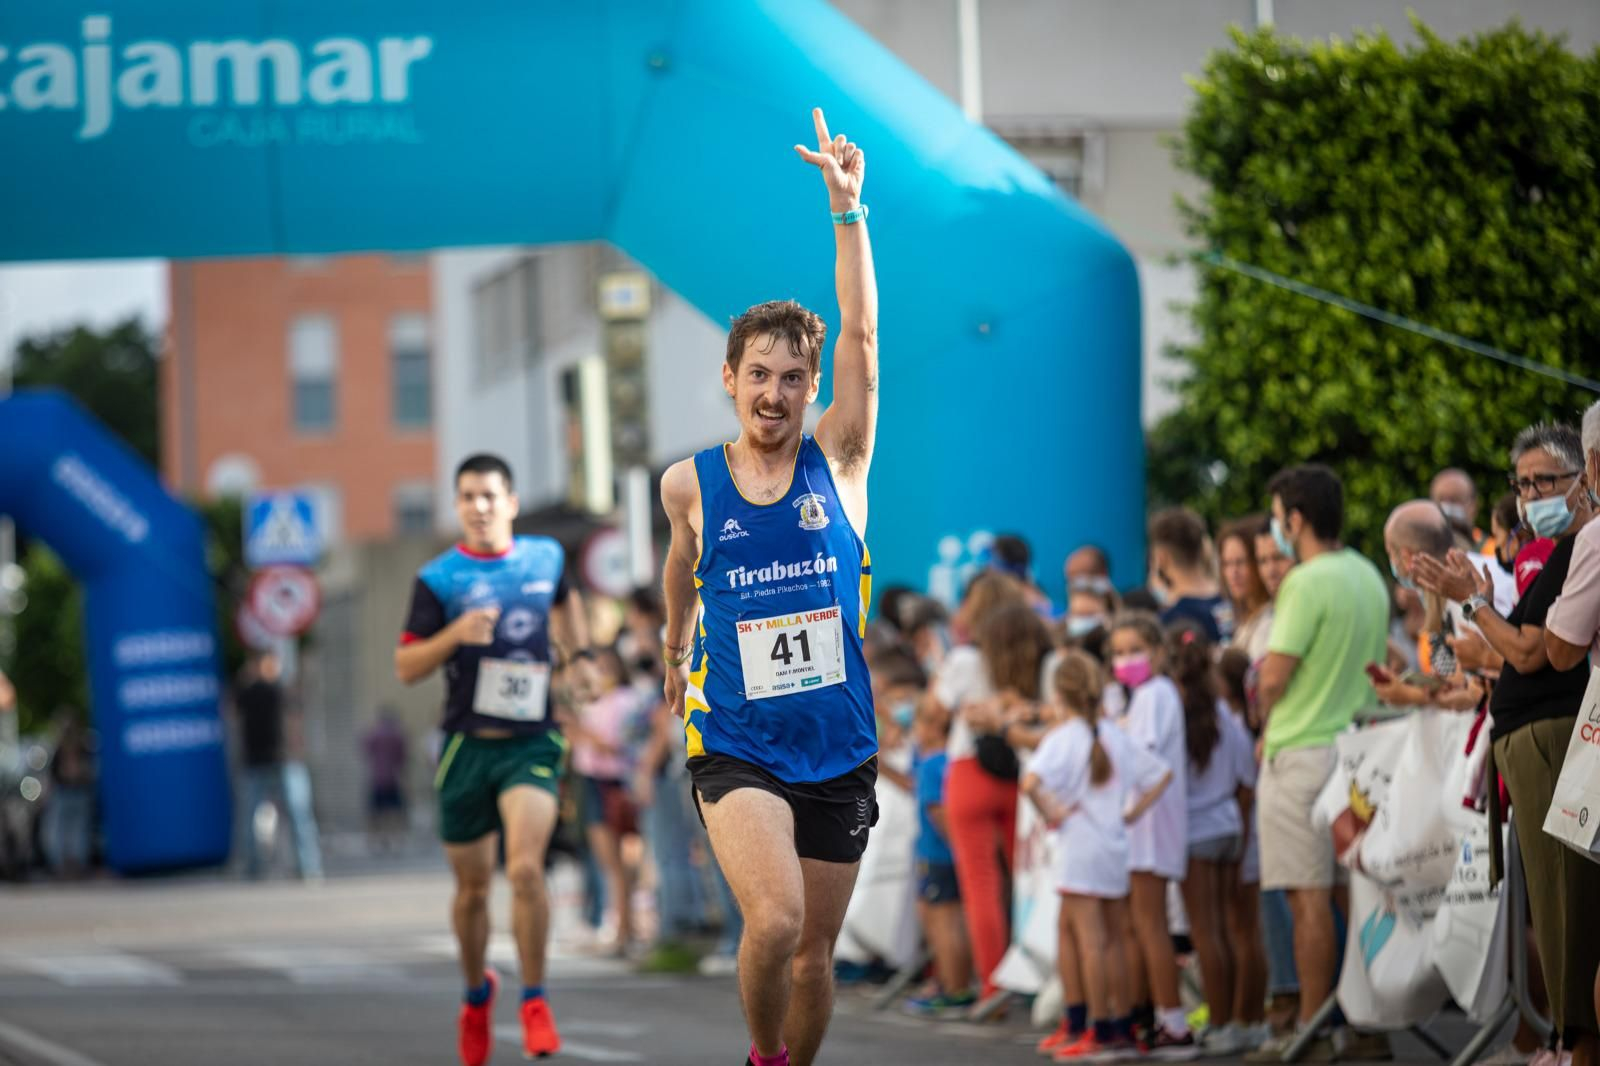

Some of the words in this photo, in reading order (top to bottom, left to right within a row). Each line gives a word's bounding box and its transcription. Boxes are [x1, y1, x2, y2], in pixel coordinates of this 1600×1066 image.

[188, 111, 288, 146] CAJA
[298, 110, 421, 144] RURAL
[726, 552, 838, 589] Tirabuzón
[754, 589, 776, 598] Piedra
[777, 584, 808, 595] Pikachos
[755, 623, 763, 631] Y
[766, 615, 802, 630] MILLA
[805, 608, 839, 624] VERDE
[770, 629, 811, 665] 41
